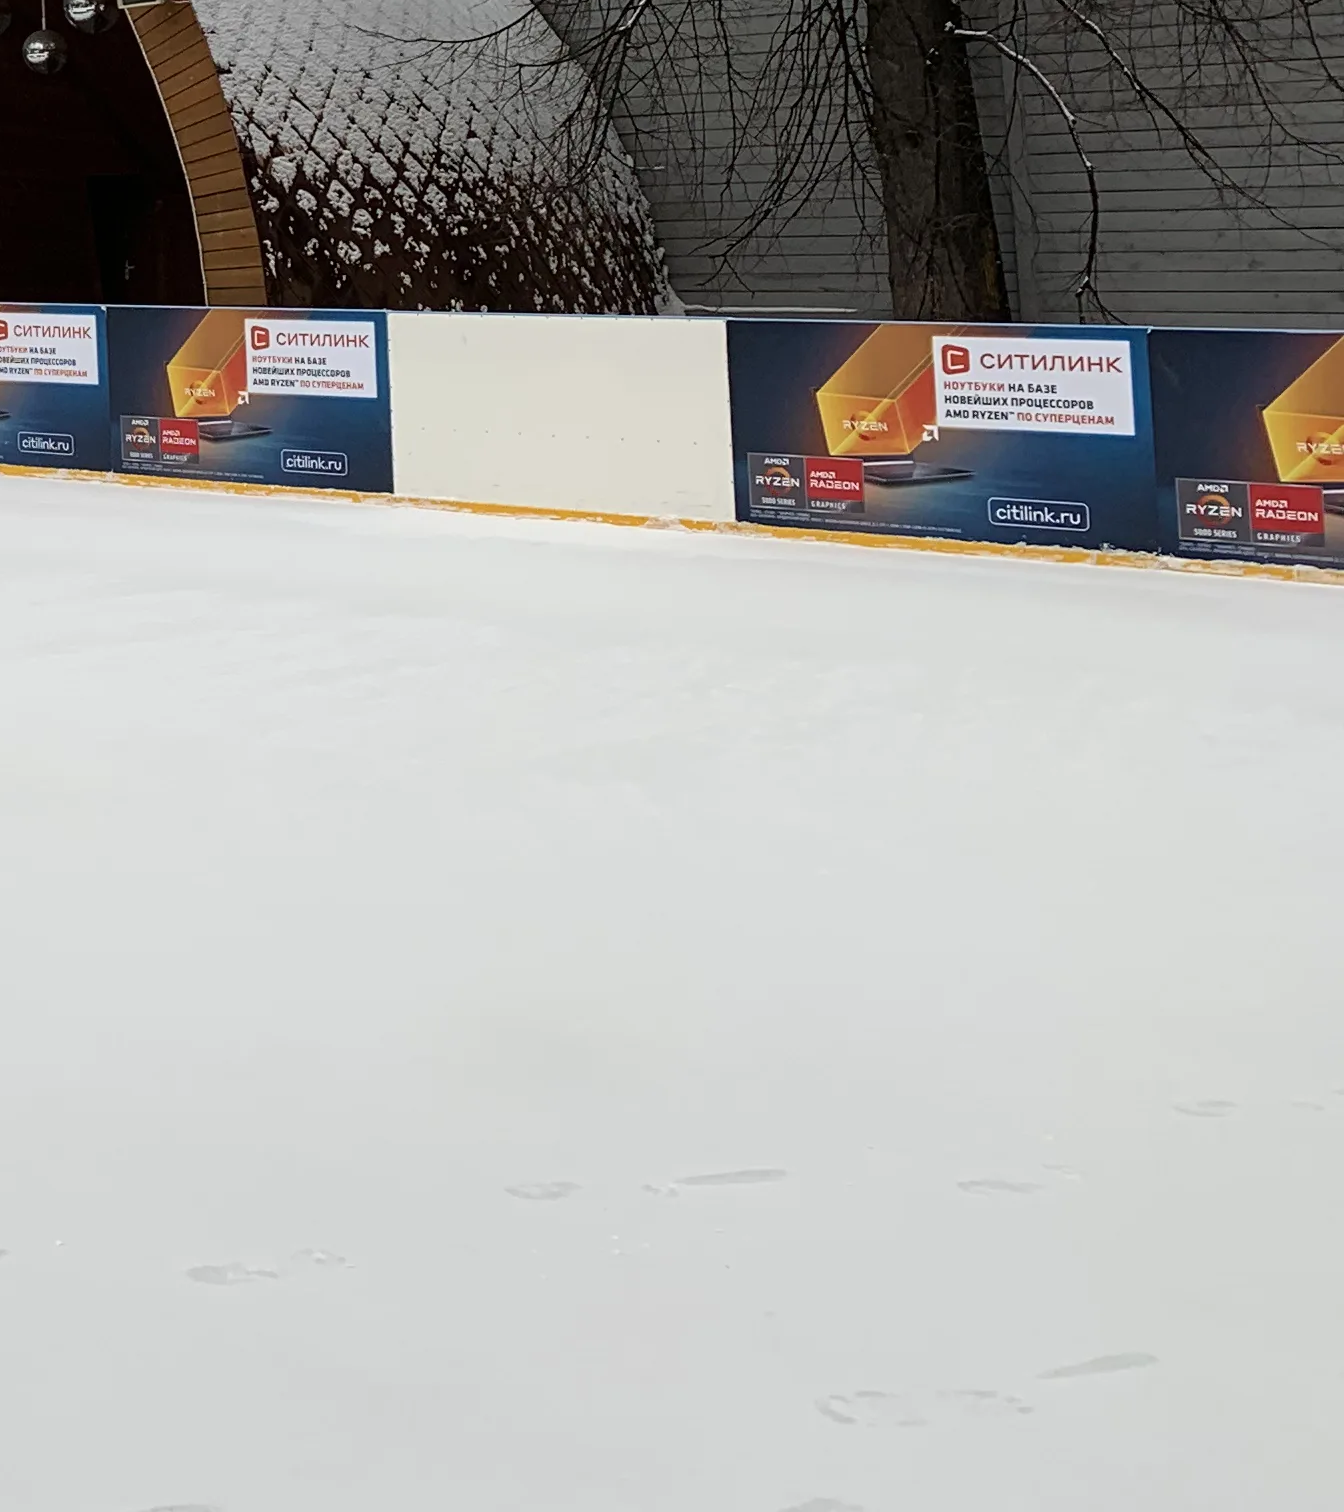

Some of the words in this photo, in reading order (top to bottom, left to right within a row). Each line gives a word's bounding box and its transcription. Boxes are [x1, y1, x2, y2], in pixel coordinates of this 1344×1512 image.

[13, 324, 92, 339] СИТИЛИНК
[276, 332, 370, 348] СИТИЛИНК
[252, 355, 293, 364] НОУТБУКИ
[294, 356, 305, 365] НА
[307, 357, 327, 365] БАЗЕ
[980, 353, 1123, 373] СИТИЛИНК
[252, 366, 295, 376] НОВЕЙШИХ
[296, 368, 351, 378] ПРОЦЕССОРОВ
[253, 378, 269, 386] AMD
[300, 380, 311, 388] ПО
[312, 380, 364, 390] СУПЕРЦЕНАМ
[944, 381, 1005, 392] НОУТБУКИ
[1008, 383, 1025, 393] НА
[1028, 383, 1057, 394] БАЗЕ
[944, 393, 1009, 406] НОВЕЙШИХ
[1011, 397, 1094, 410] ПРОЦЕССОРОВ
[945, 409, 970, 419] AMD
[1017, 412, 1033, 422] ПО
[1035, 412, 1115, 426] СУПЕРЦЕНАМ
[842, 419, 889, 432] RYZEN
[22, 437, 70, 452] citilink.ru
[125, 433, 156, 444] RYZEN
[162, 436, 197, 445] RADEON
[1296, 441, 1344, 455] RYZE
[286, 454, 342, 471] citilink.ru
[755, 475, 800, 488] RYZEN
[810, 479, 860, 491] RADEON
[1197, 483, 1220, 494] AMD
[1255, 498, 1279, 508] AMD
[996, 505, 1081, 525] citilink.ru
[1185, 504, 1243, 518] RYZEN
[1255, 508, 1319, 522] RADEON
[1257, 532, 1301, 544] GRAPHICS
